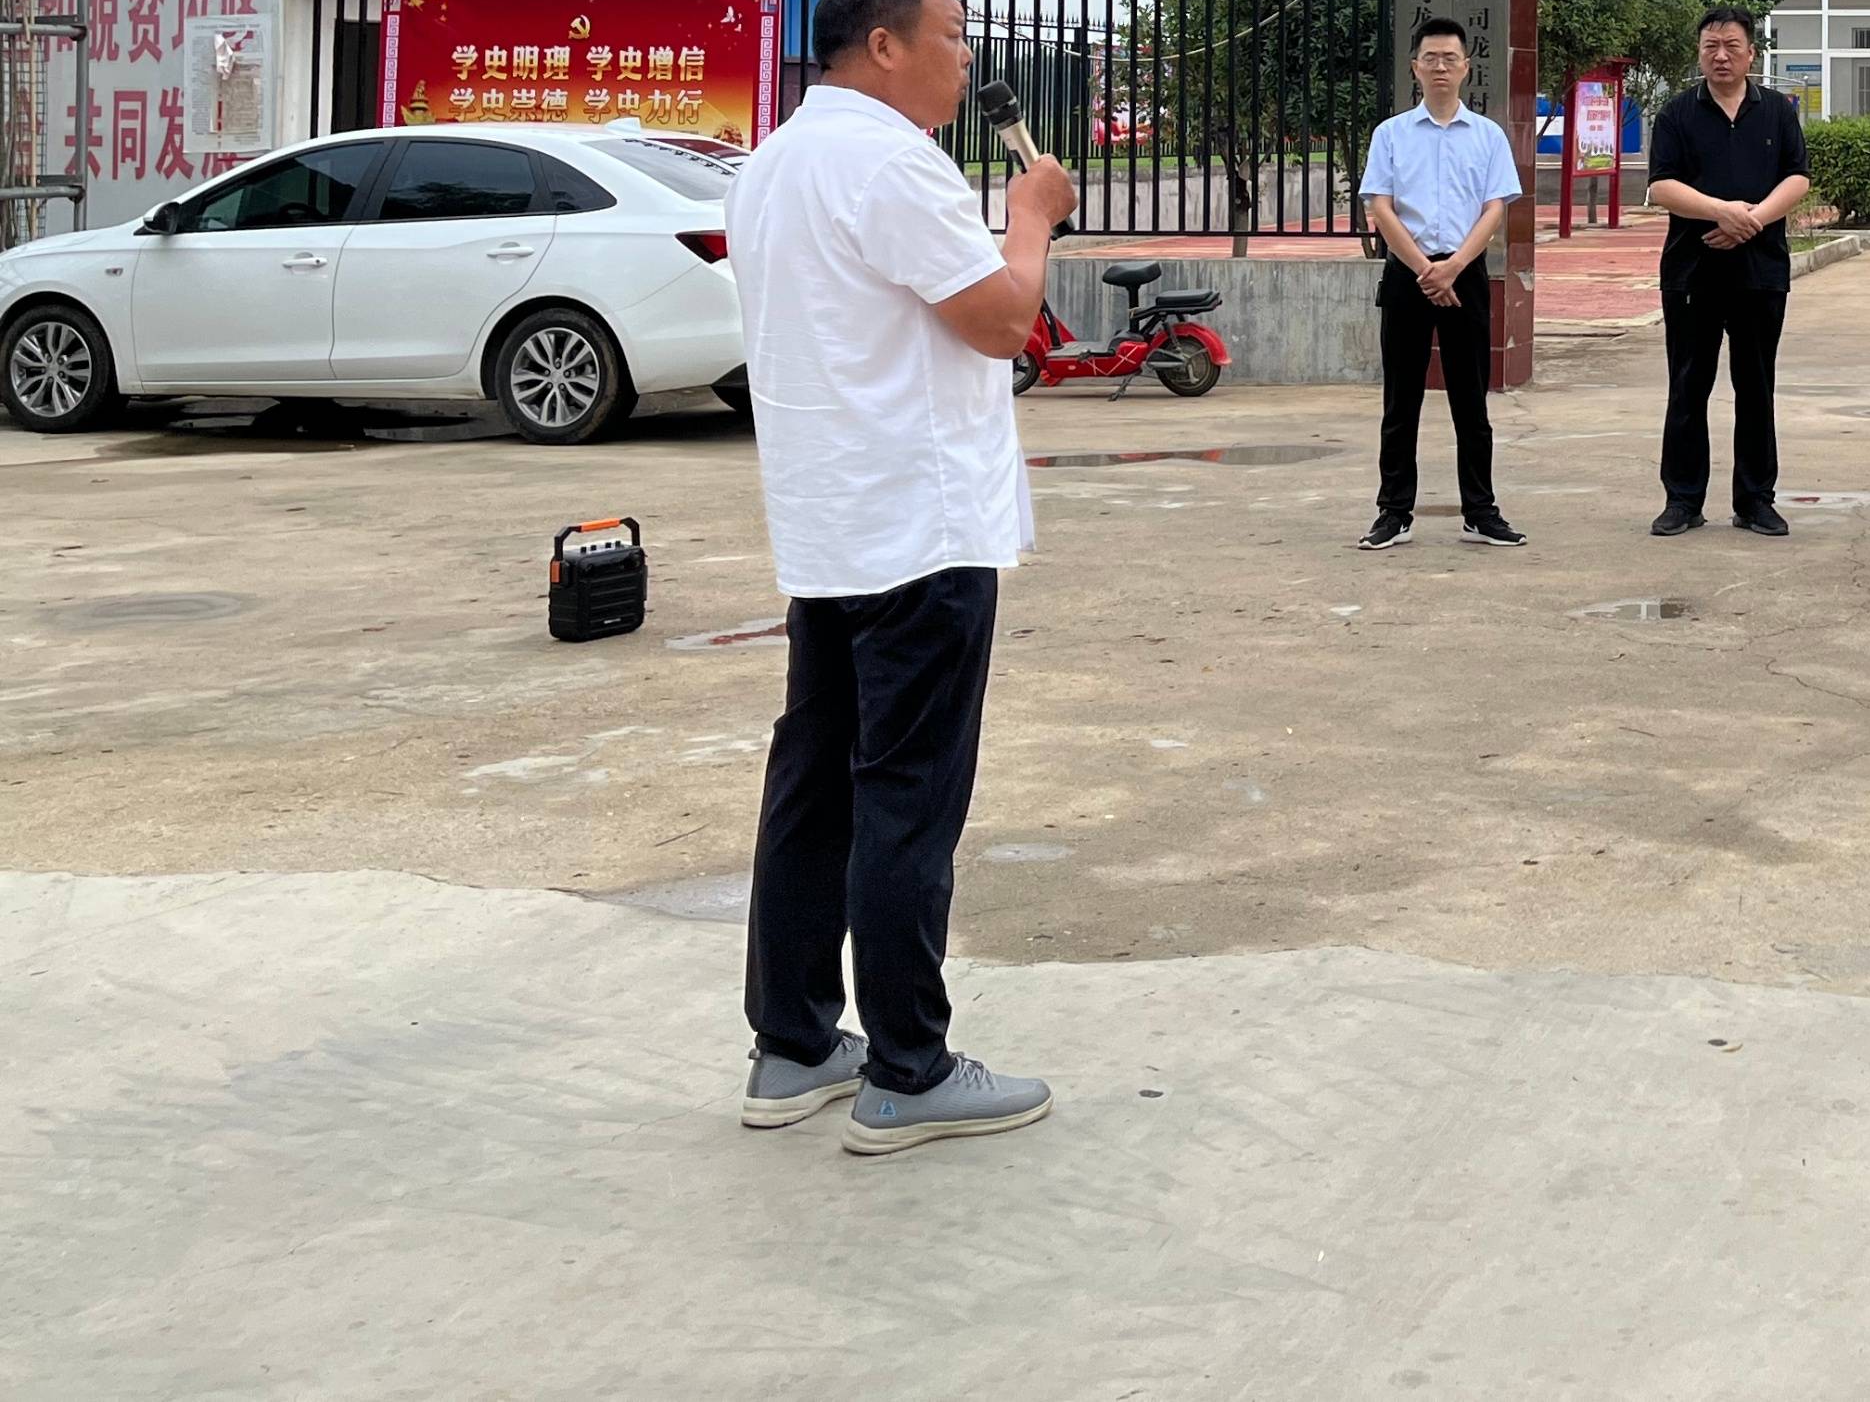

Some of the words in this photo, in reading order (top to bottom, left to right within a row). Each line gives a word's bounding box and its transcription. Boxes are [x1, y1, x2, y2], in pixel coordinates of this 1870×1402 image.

[450, 44, 572, 82] 学史明理
[585, 44, 706, 83] 学史增信
[448, 87, 569, 123] 学史崇德
[583, 88, 704, 126] 学史力行
